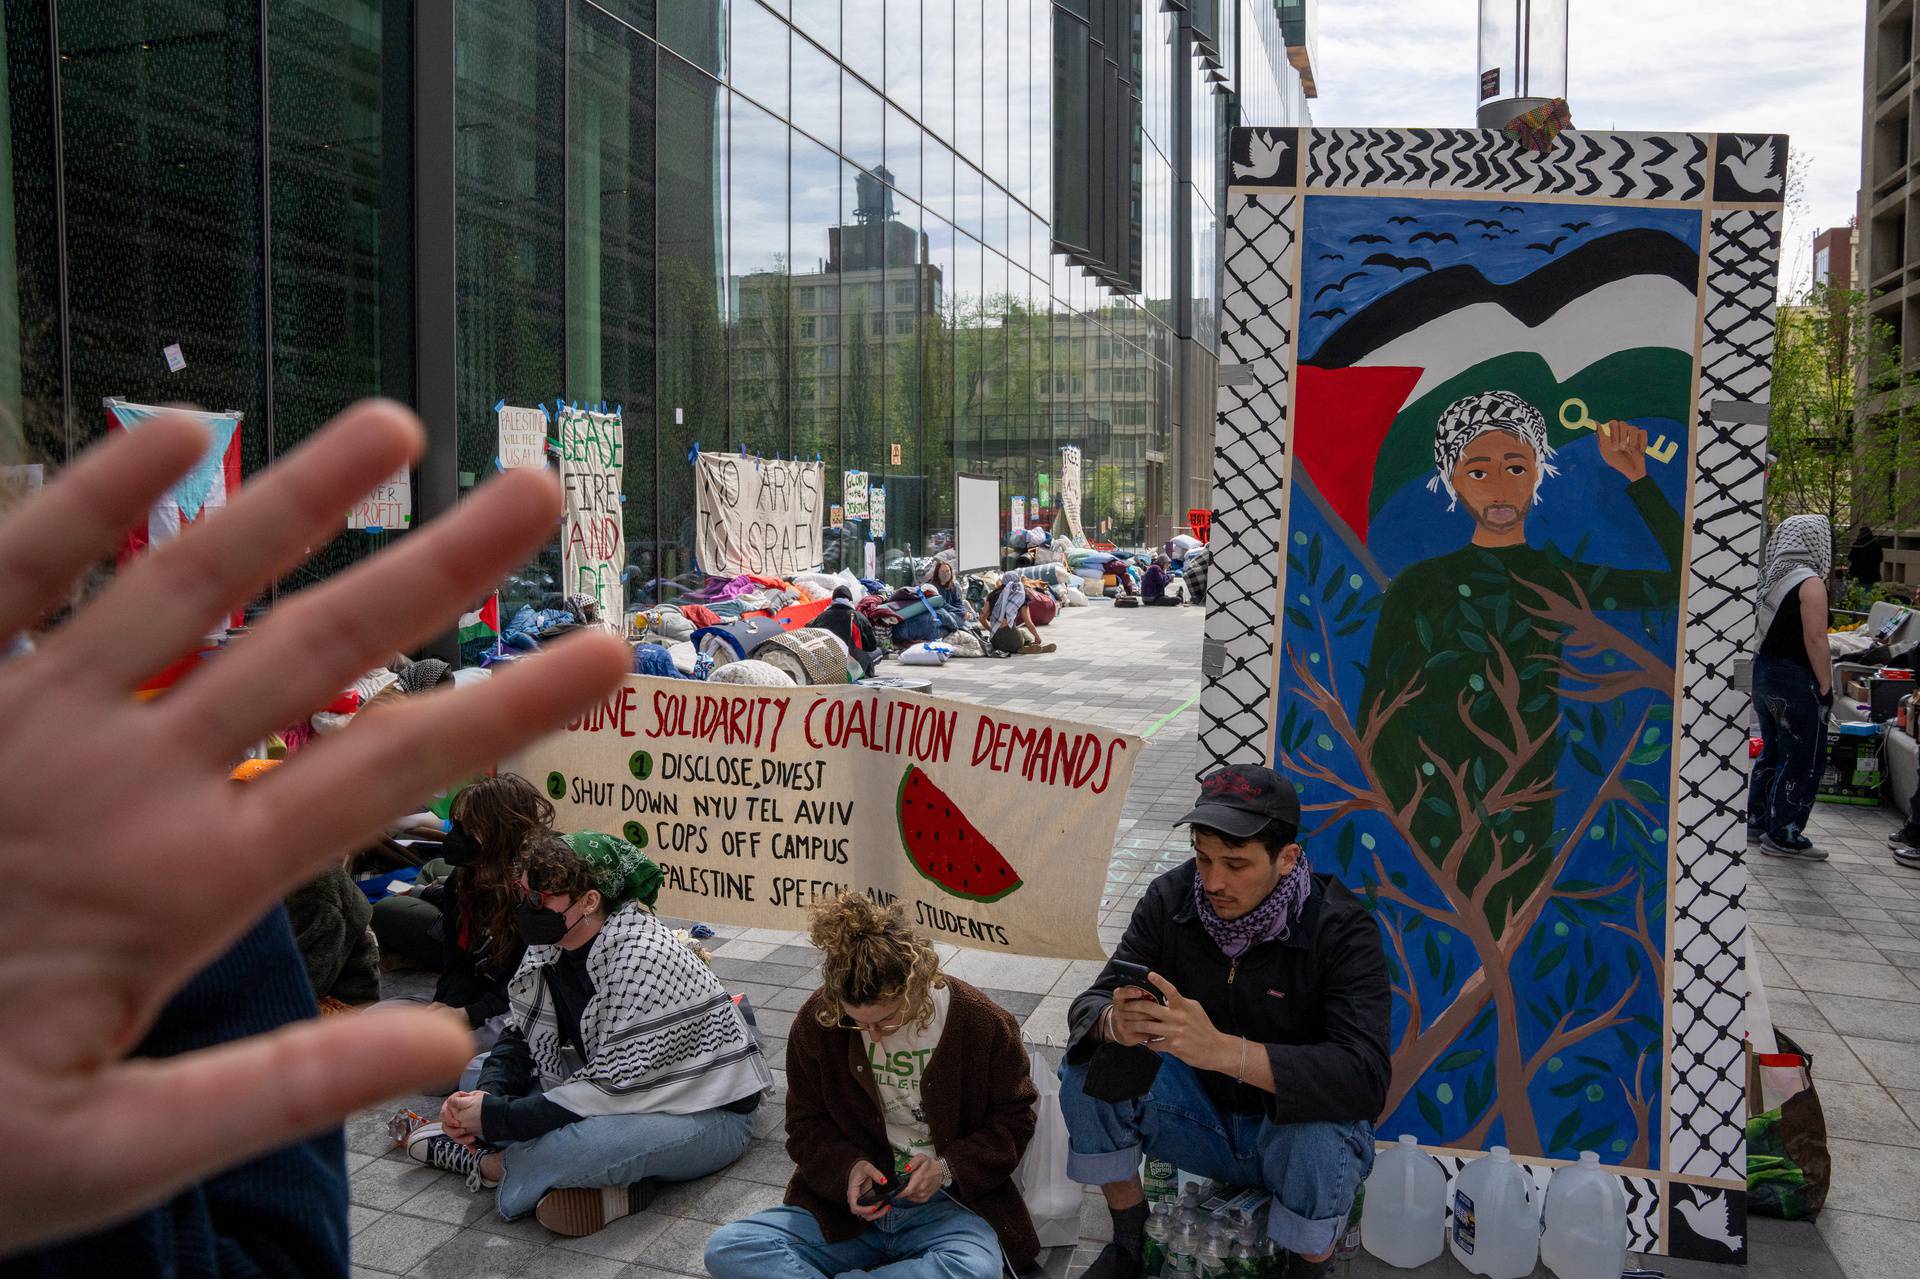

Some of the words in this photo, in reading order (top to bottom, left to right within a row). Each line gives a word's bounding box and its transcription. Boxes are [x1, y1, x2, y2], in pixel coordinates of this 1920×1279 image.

[501, 411, 546, 433] PALESTINE
[503, 434, 520, 446] WILL
[562, 415, 622, 468] CEASE
[370, 486, 397, 502] VER
[565, 473, 616, 514] FIRE
[703, 459, 740, 508] NO
[756, 466, 817, 513] ARMS
[354, 502, 402, 528] PROFIT
[566, 517, 619, 560] AND
[701, 511, 729, 573] TO
[740, 521, 823, 574] ISRAEL
[645, 690, 791, 752] SOLIDARITY
[804, 693, 958, 763] COALITION
[971, 715, 1127, 794] DEMANDS
[571, 777, 614, 806] SHUT
[622, 784, 678, 815] DOWN
[693, 795, 737, 820] NYU
[746, 797, 783, 822] TEL
[794, 799, 854, 825] AVIV
[656, 821, 707, 853] COPS
[722, 831, 761, 857] OFF
[772, 833, 849, 864] CAMPUS
[660, 862, 755, 901] PALESTINE
[916, 900, 1009, 945] STUDENTS
